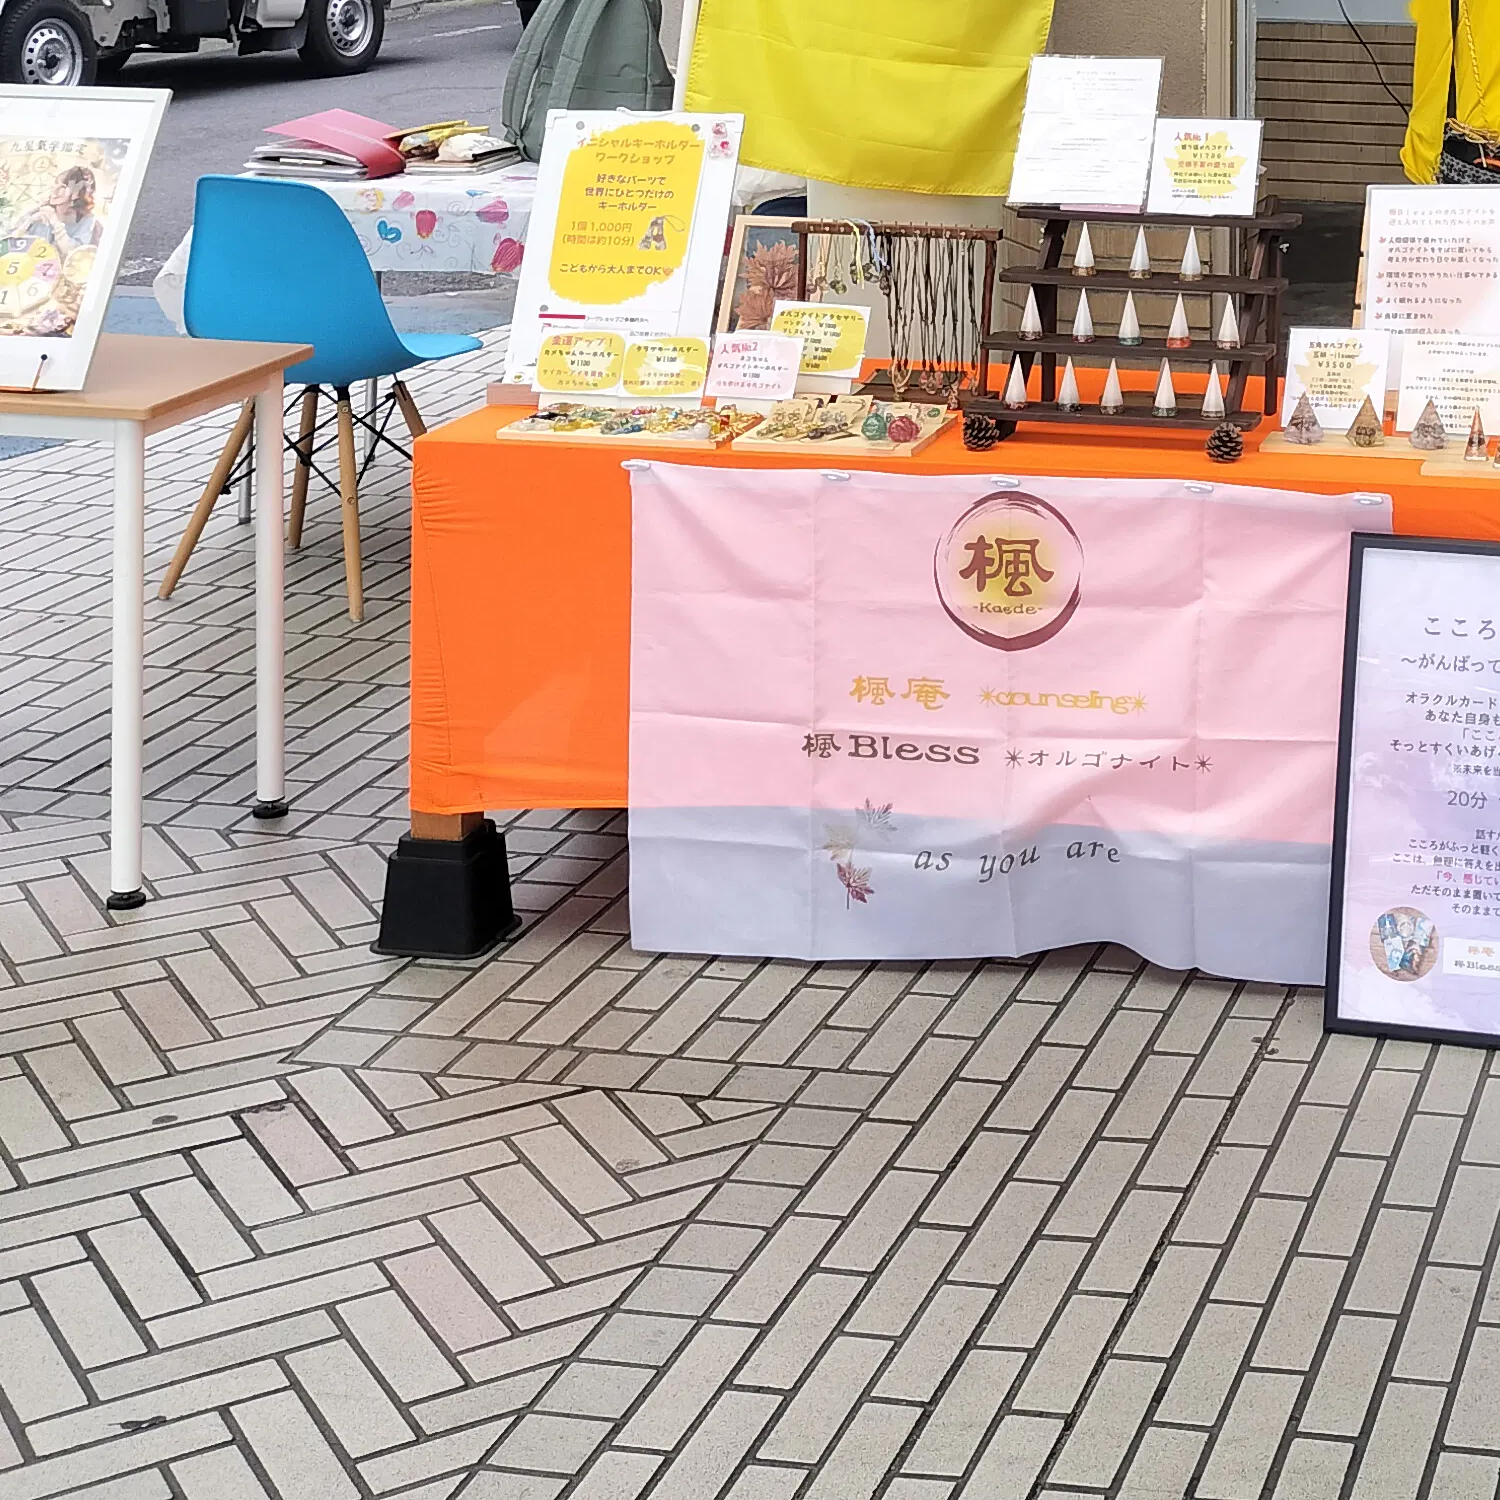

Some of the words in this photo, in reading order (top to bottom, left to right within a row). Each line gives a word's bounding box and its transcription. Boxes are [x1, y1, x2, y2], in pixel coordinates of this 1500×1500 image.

[576, 136, 700, 150] イニシャルキーホルダー
[595, 152, 676, 165] ワークショップ
[596, 173, 666, 186] 好きなパーツで
[584, 187, 674, 200] 世界にひとつだけの
[598, 201, 658, 212] キーホルダー
[590, 222, 632, 234] 1,000円
[559, 263, 662, 276] こどもから大人までOK
[1386, 281, 1428, 290] ようになった
[958, 533, 1055, 597] 楓
[848, 675, 951, 712] 楓庵
[1027, 747, 1194, 772] オルゴナイト
[1446, 789, 1488, 810] 20分
[914, 847, 952, 872] as
[978, 843, 1041, 884] you
[1066, 837, 1122, 866] are
